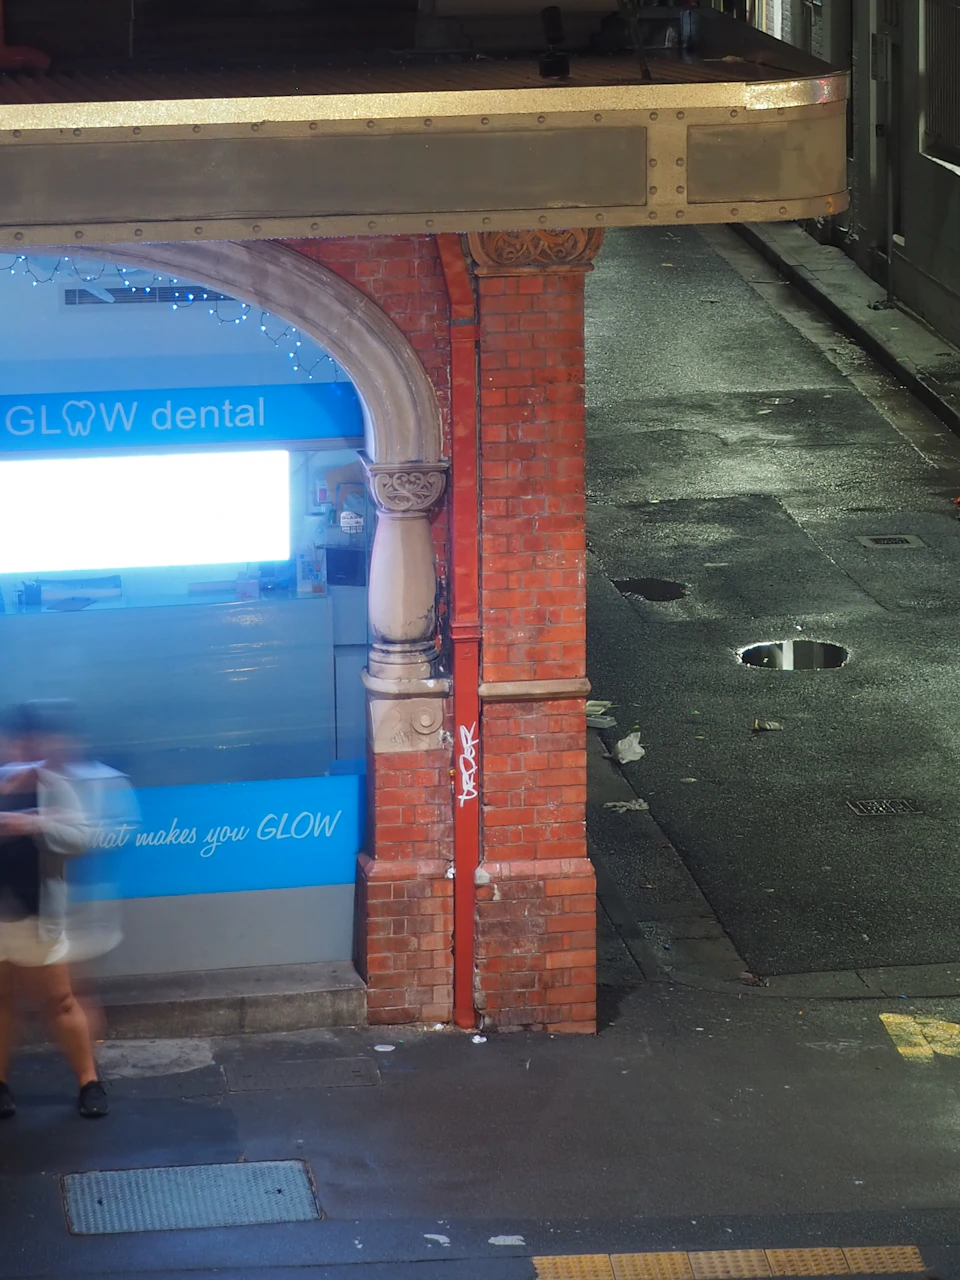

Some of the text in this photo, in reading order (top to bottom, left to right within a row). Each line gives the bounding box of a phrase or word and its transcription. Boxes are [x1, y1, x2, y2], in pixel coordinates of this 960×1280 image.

[151, 397, 265, 431] dental
[135, 817, 197, 846] makes
[200, 824, 250, 858] you
[256, 809, 343, 841] GLOW
